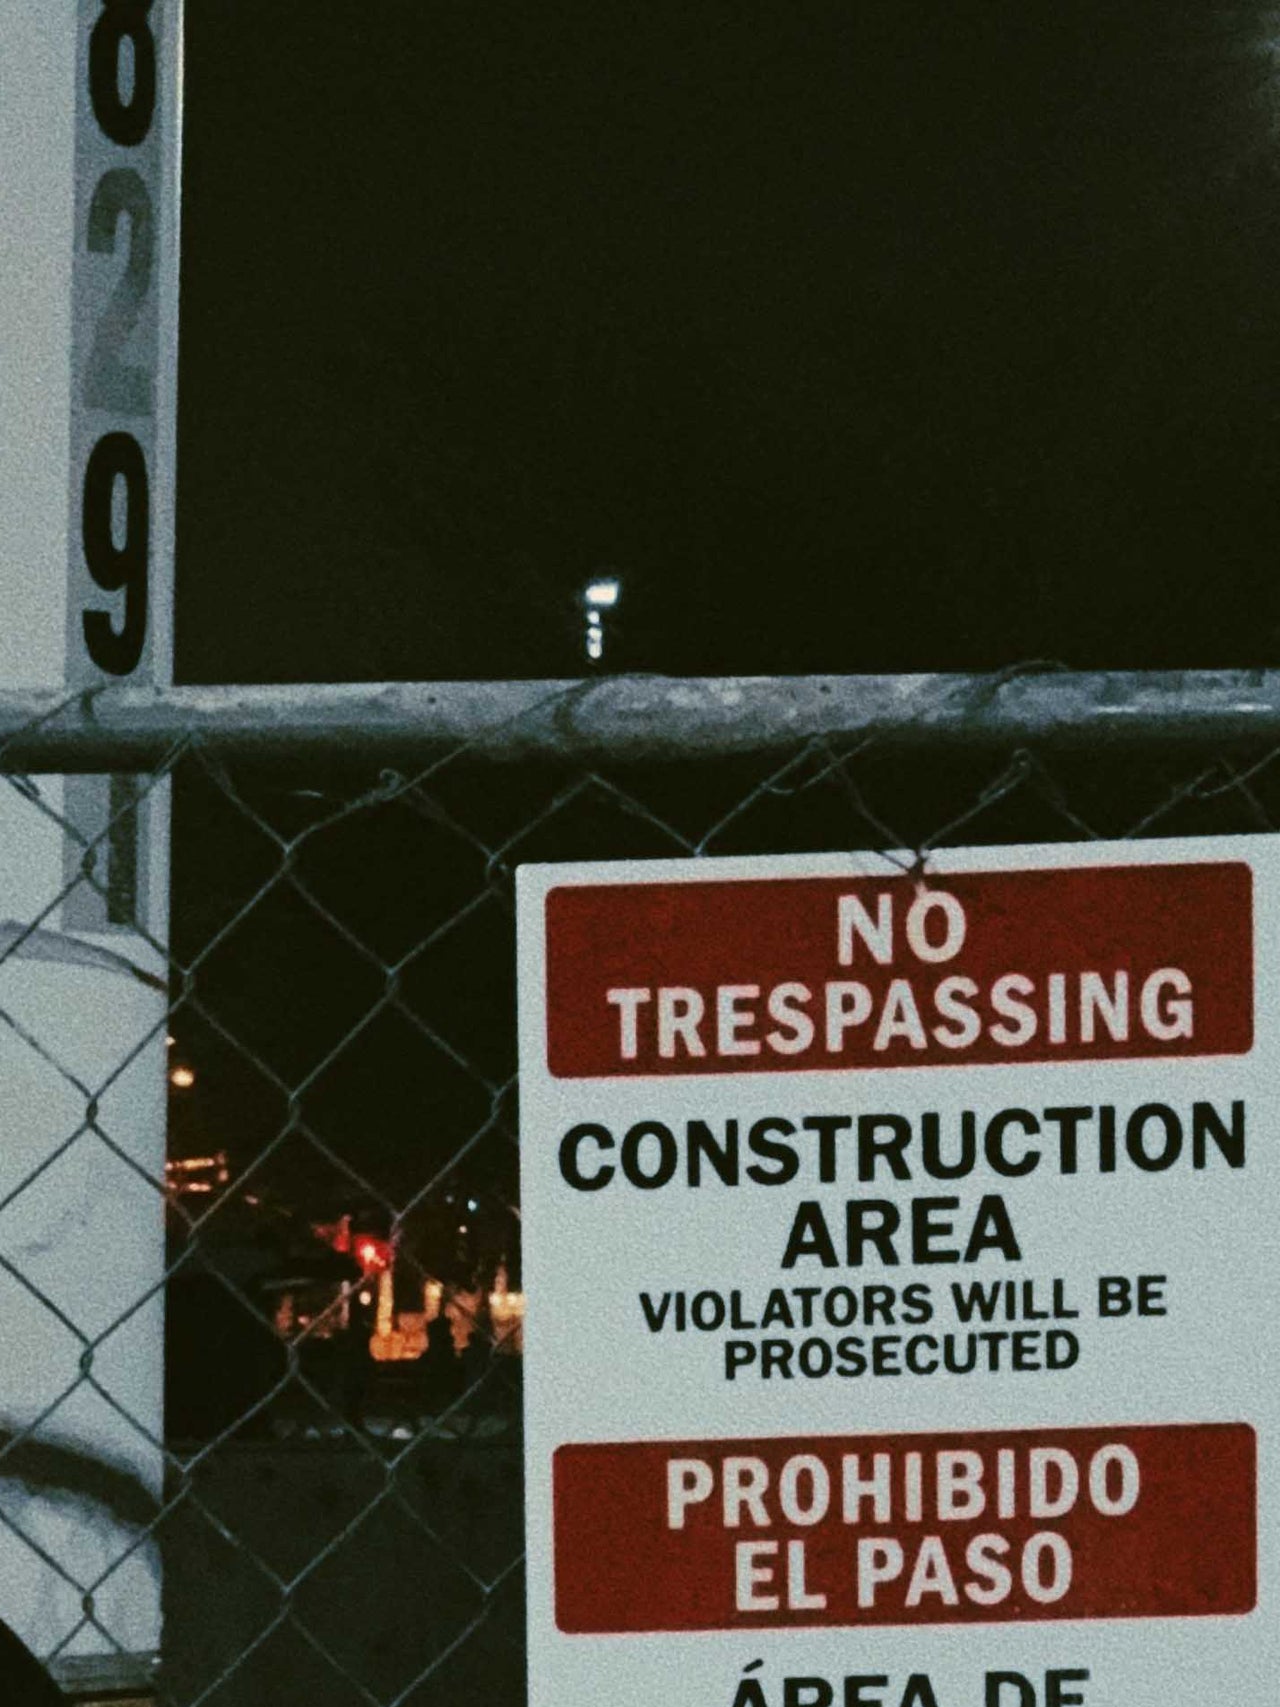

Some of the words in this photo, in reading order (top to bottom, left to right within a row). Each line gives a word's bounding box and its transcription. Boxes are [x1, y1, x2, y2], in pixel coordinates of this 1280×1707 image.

[839, 890, 966, 966] NO
[606, 968, 1195, 1059] TRESPASSING
[558, 1100, 1246, 1192] CONSTRUCTION
[780, 1194, 1022, 1269] AREA
[639, 1284, 934, 1333] VIOLATORS
[950, 1279, 1079, 1324] WILL
[1098, 1275, 1168, 1318] BE
[723, 1330, 1081, 1381] PROSECUTED
[665, 1443, 1141, 1530] PROHIBIDO
[735, 1540, 828, 1612] EL
[856, 1531, 1073, 1608] PASO
